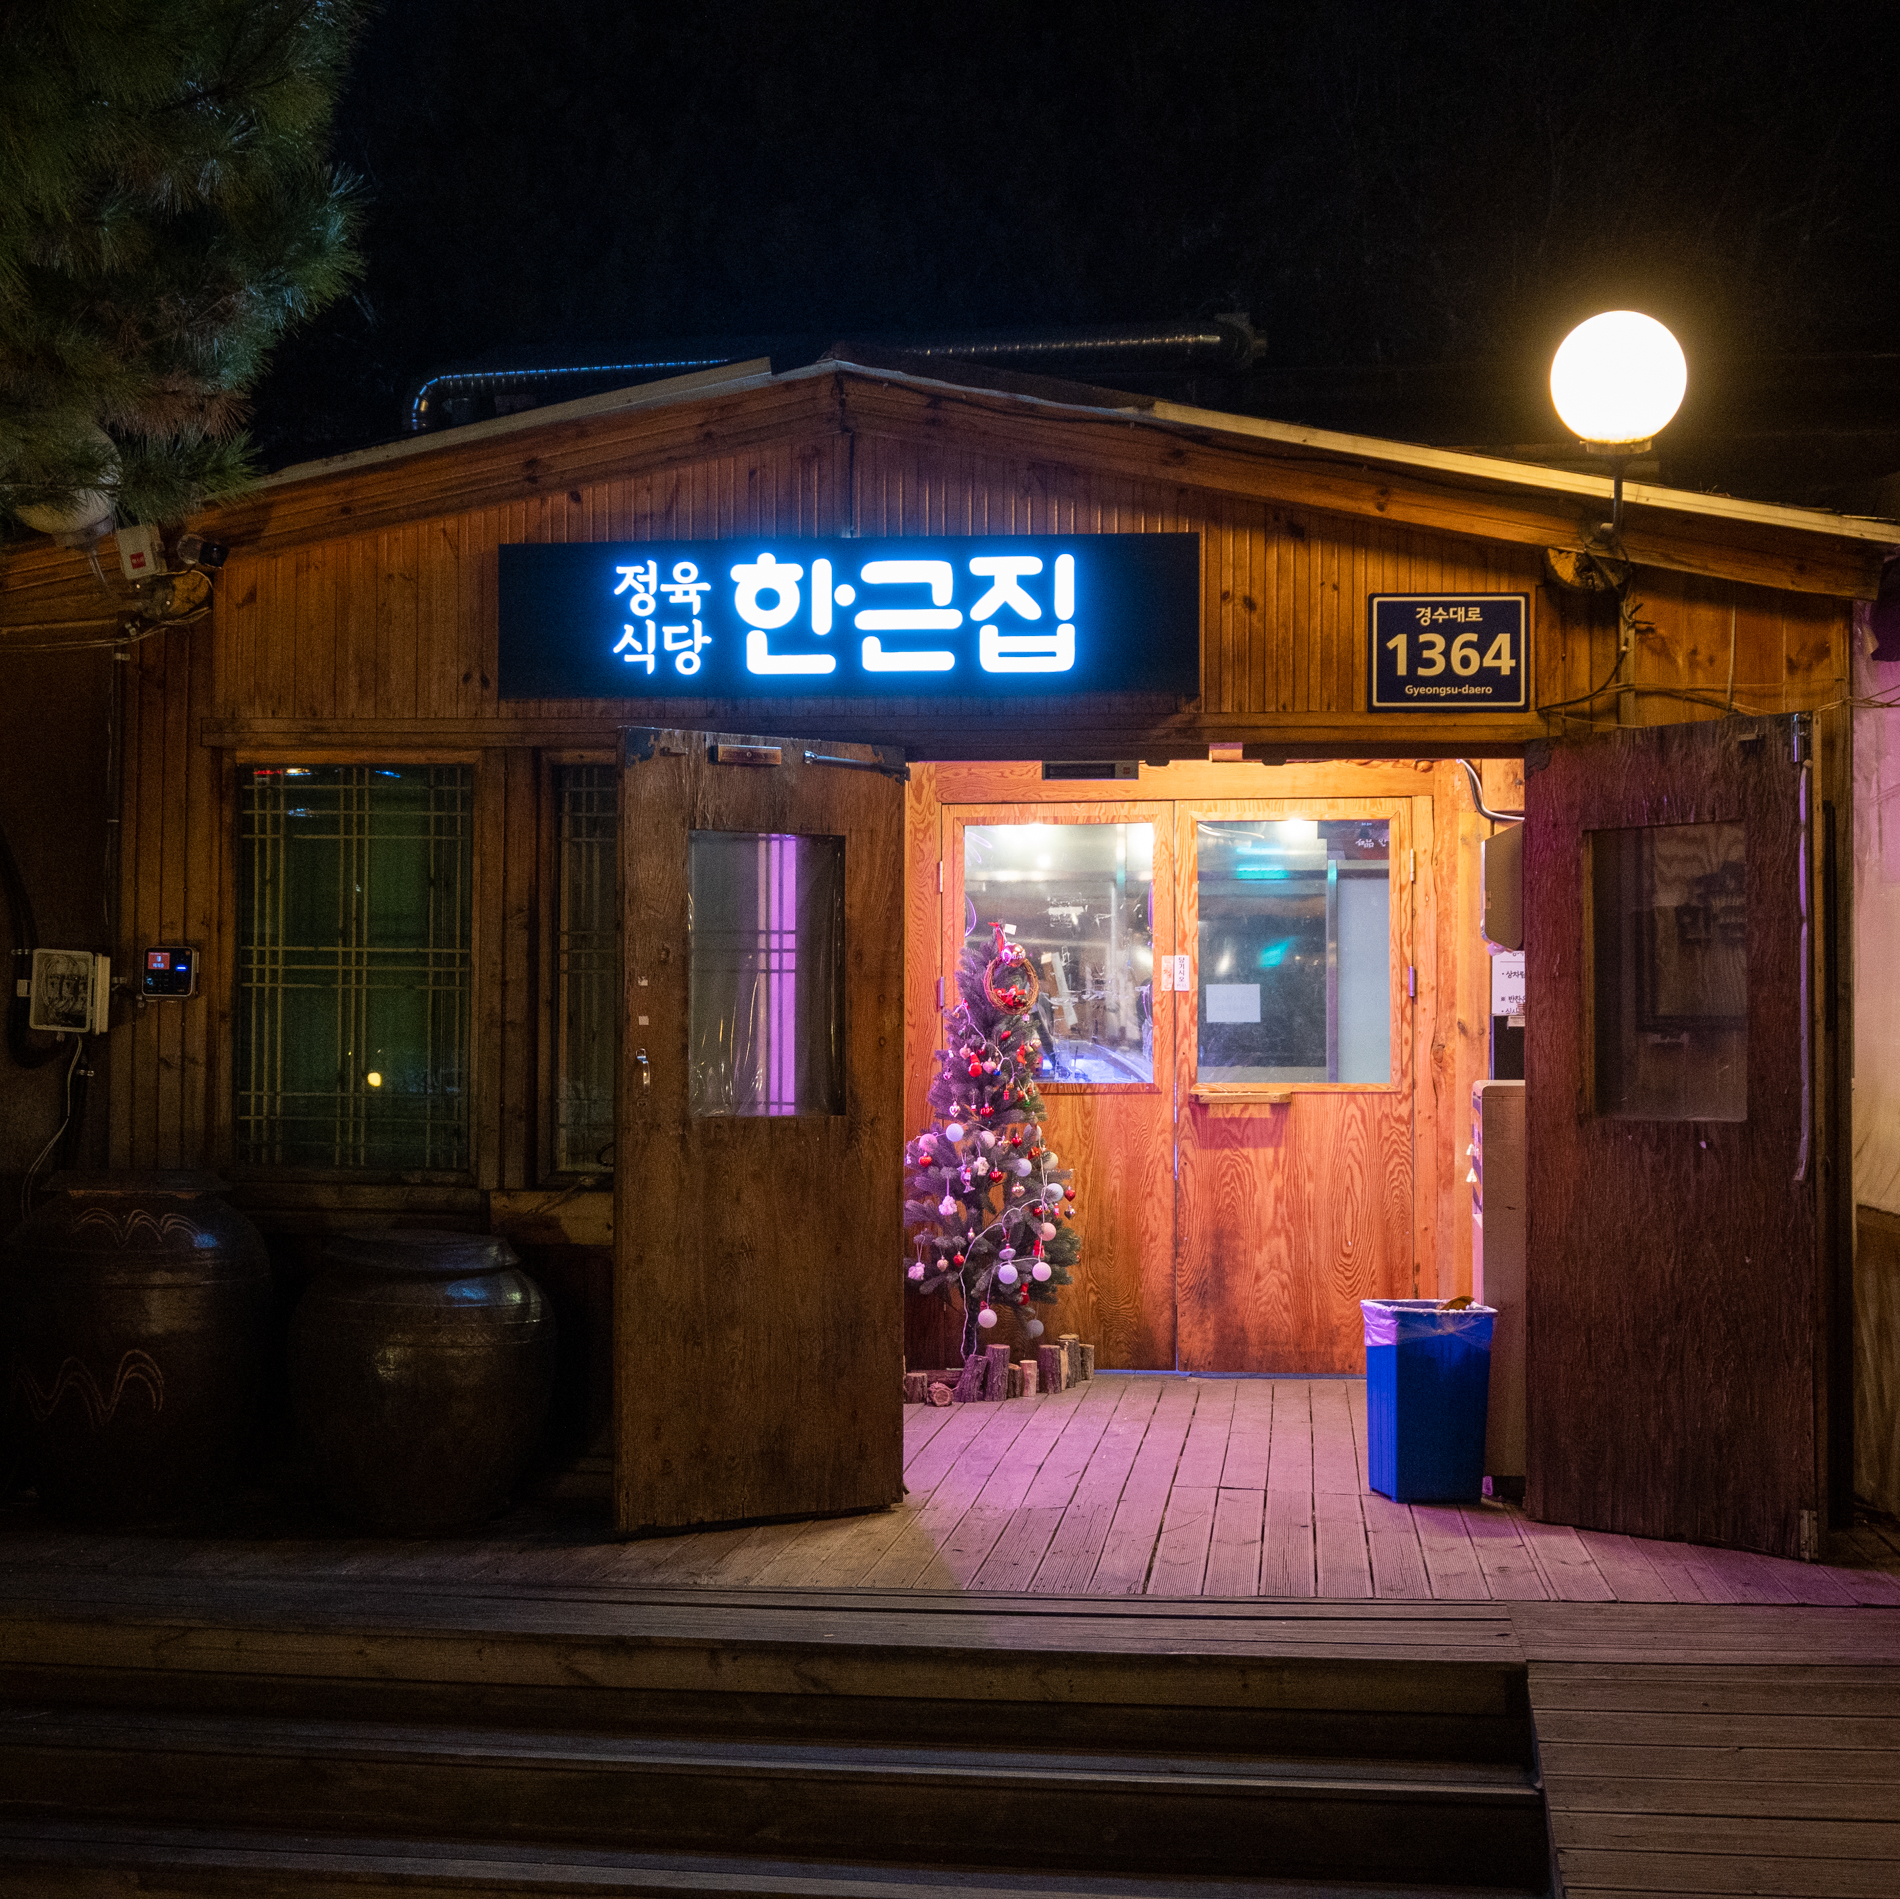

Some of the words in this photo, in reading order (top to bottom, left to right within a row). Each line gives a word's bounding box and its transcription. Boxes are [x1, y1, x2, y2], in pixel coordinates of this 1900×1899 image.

[614, 559, 711, 617] 정육
[730, 552, 1075, 675] 한근집
[1415, 606, 1483, 626] 경수대로
[613, 618, 712, 675] 식당
[1386, 633, 1516, 676] 1364
[1405, 684, 1493, 697] Gyeongsu-daero
